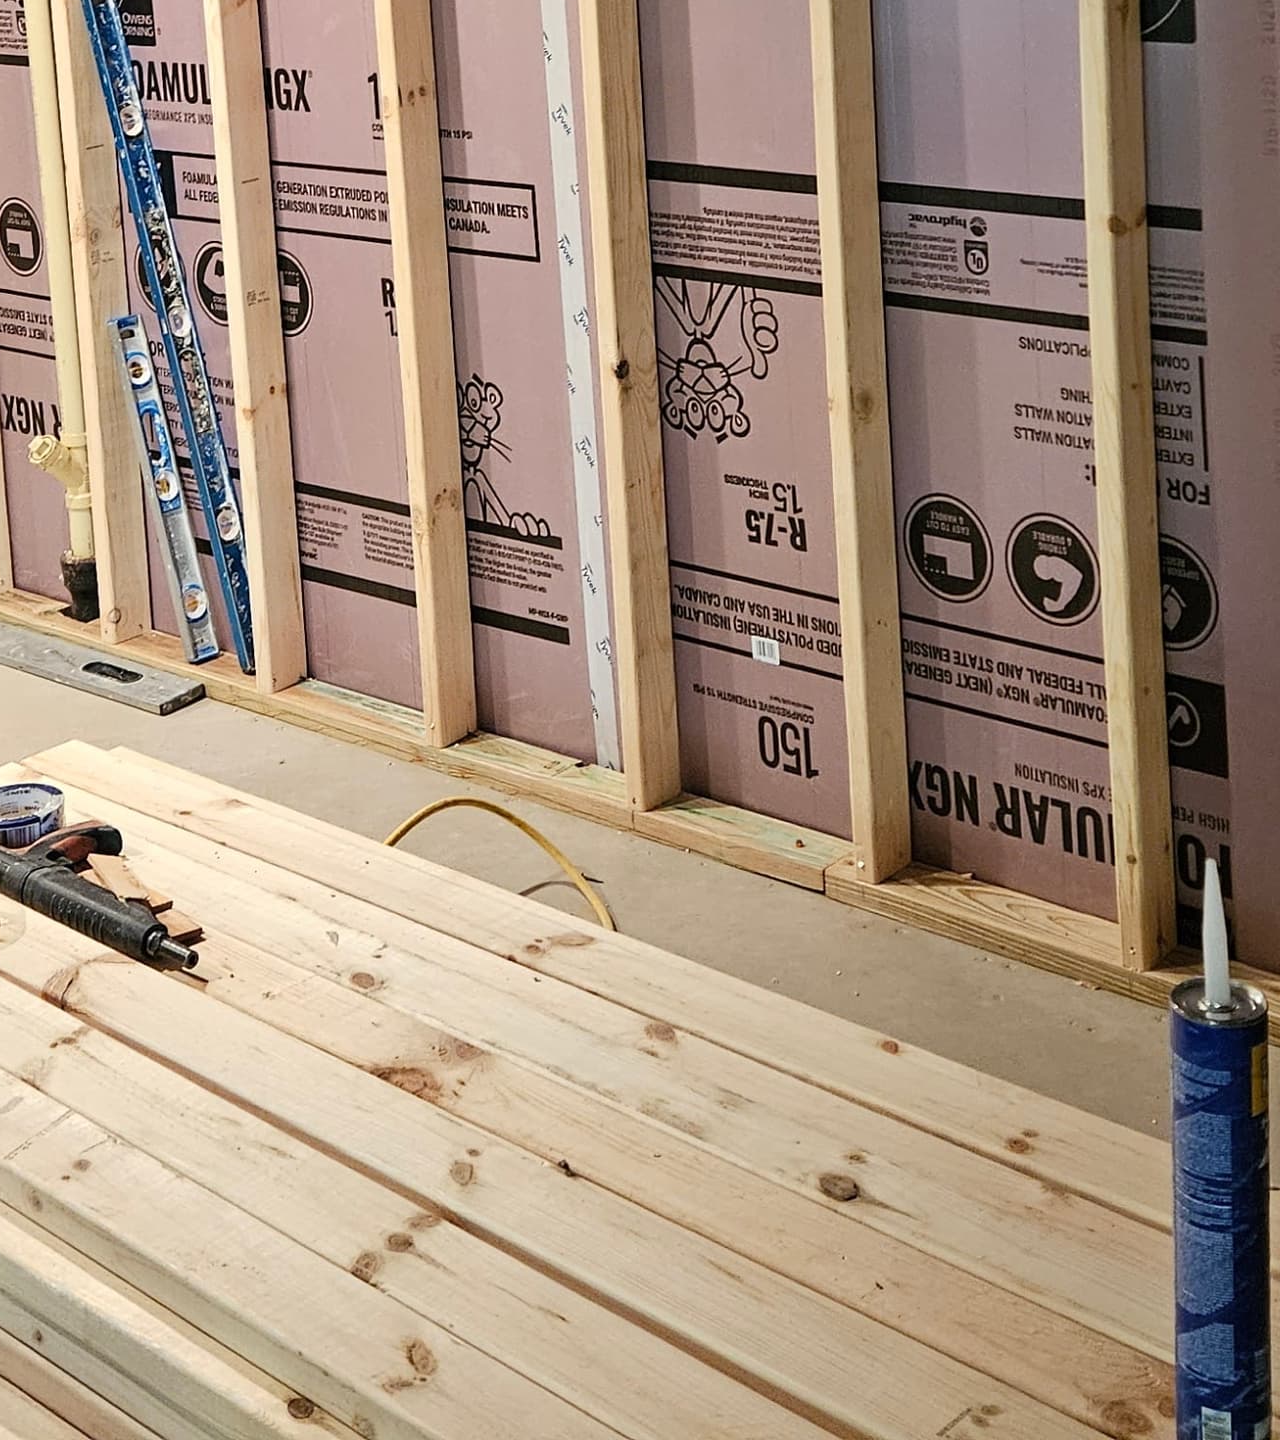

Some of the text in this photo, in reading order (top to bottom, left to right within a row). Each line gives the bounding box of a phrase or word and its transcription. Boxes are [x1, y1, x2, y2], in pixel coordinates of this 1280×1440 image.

[134, 61, 211, 105] OAMUL
[908, 213, 967, 229] hydrovac
[1, 393, 45, 436] NGX
[771, 481, 804, 514] 1.5
[1167, 478, 1210, 506] FOR
[744, 508, 808, 553] R-7.5
[757, 715, 820, 780] 150
